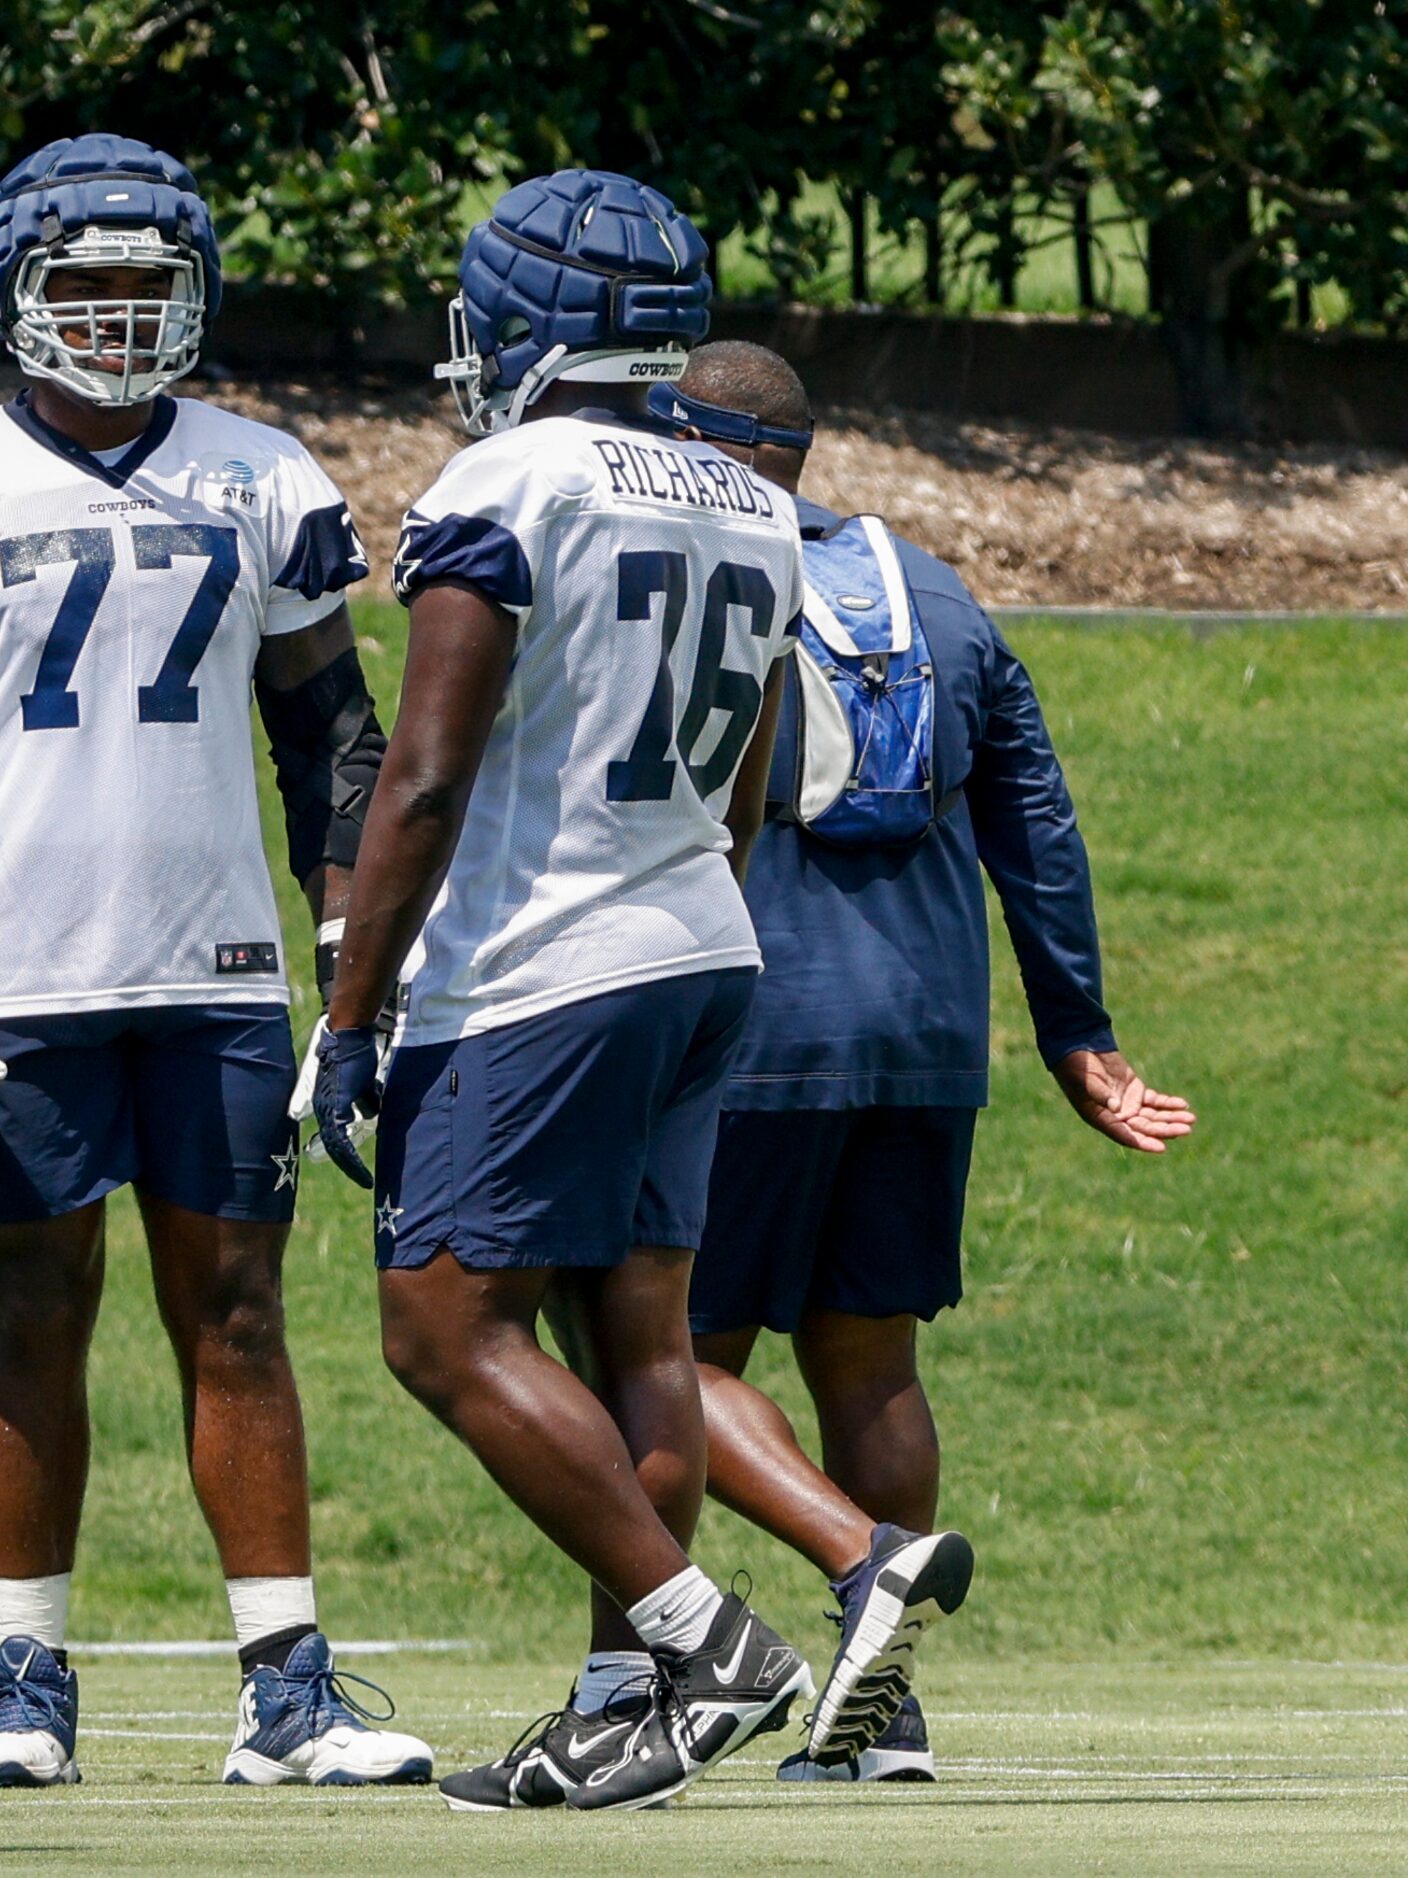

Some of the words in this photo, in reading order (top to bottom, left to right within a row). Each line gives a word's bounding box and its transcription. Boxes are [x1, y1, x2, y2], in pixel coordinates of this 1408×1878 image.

[101, 233, 142, 243] COWBOYS
[592, 439, 774, 518] RICHARDS
[88, 499, 157, 513] COWBOYS
[221, 486, 257, 507] AT&T
[606, 550, 777, 804] 76
